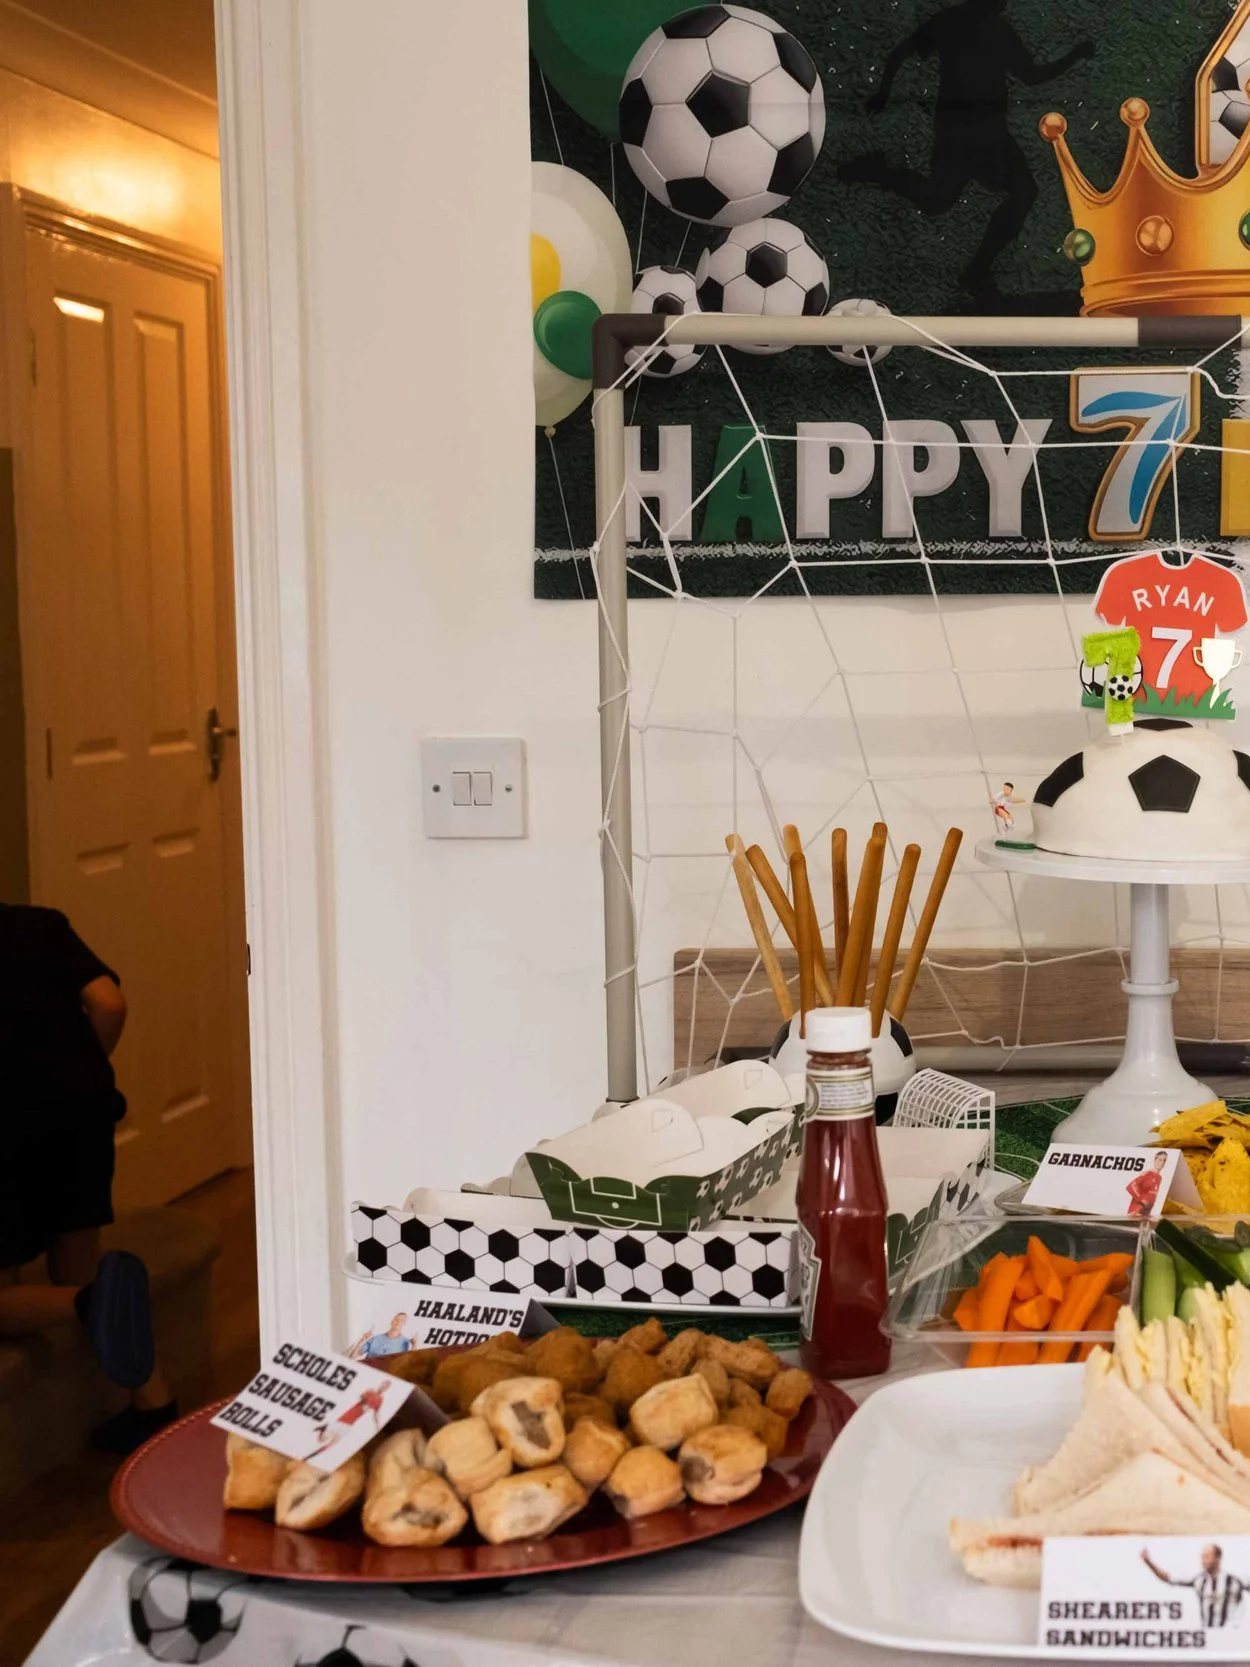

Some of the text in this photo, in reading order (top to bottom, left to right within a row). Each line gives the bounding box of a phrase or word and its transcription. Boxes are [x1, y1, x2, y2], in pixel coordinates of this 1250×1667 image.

[625, 418, 1053, 542] HAPPY
[1069, 366, 1200, 542] 7
[1132, 584, 1215, 617] RYAN
[1081, 626, 1141, 724] 7
[1151, 626, 1193, 689] 7
[1047, 1152, 1146, 1172] GARNACHOS
[414, 1299, 524, 1329] HAALAND'S
[272, 1342, 356, 1392] SCHOLES
[247, 1373, 336, 1423] SAUSAGE
[219, 1401, 284, 1438] ROLLS
[1048, 1600, 1183, 1621] SHEARER'S
[1046, 1629, 1206, 1649] SANDWICHES
